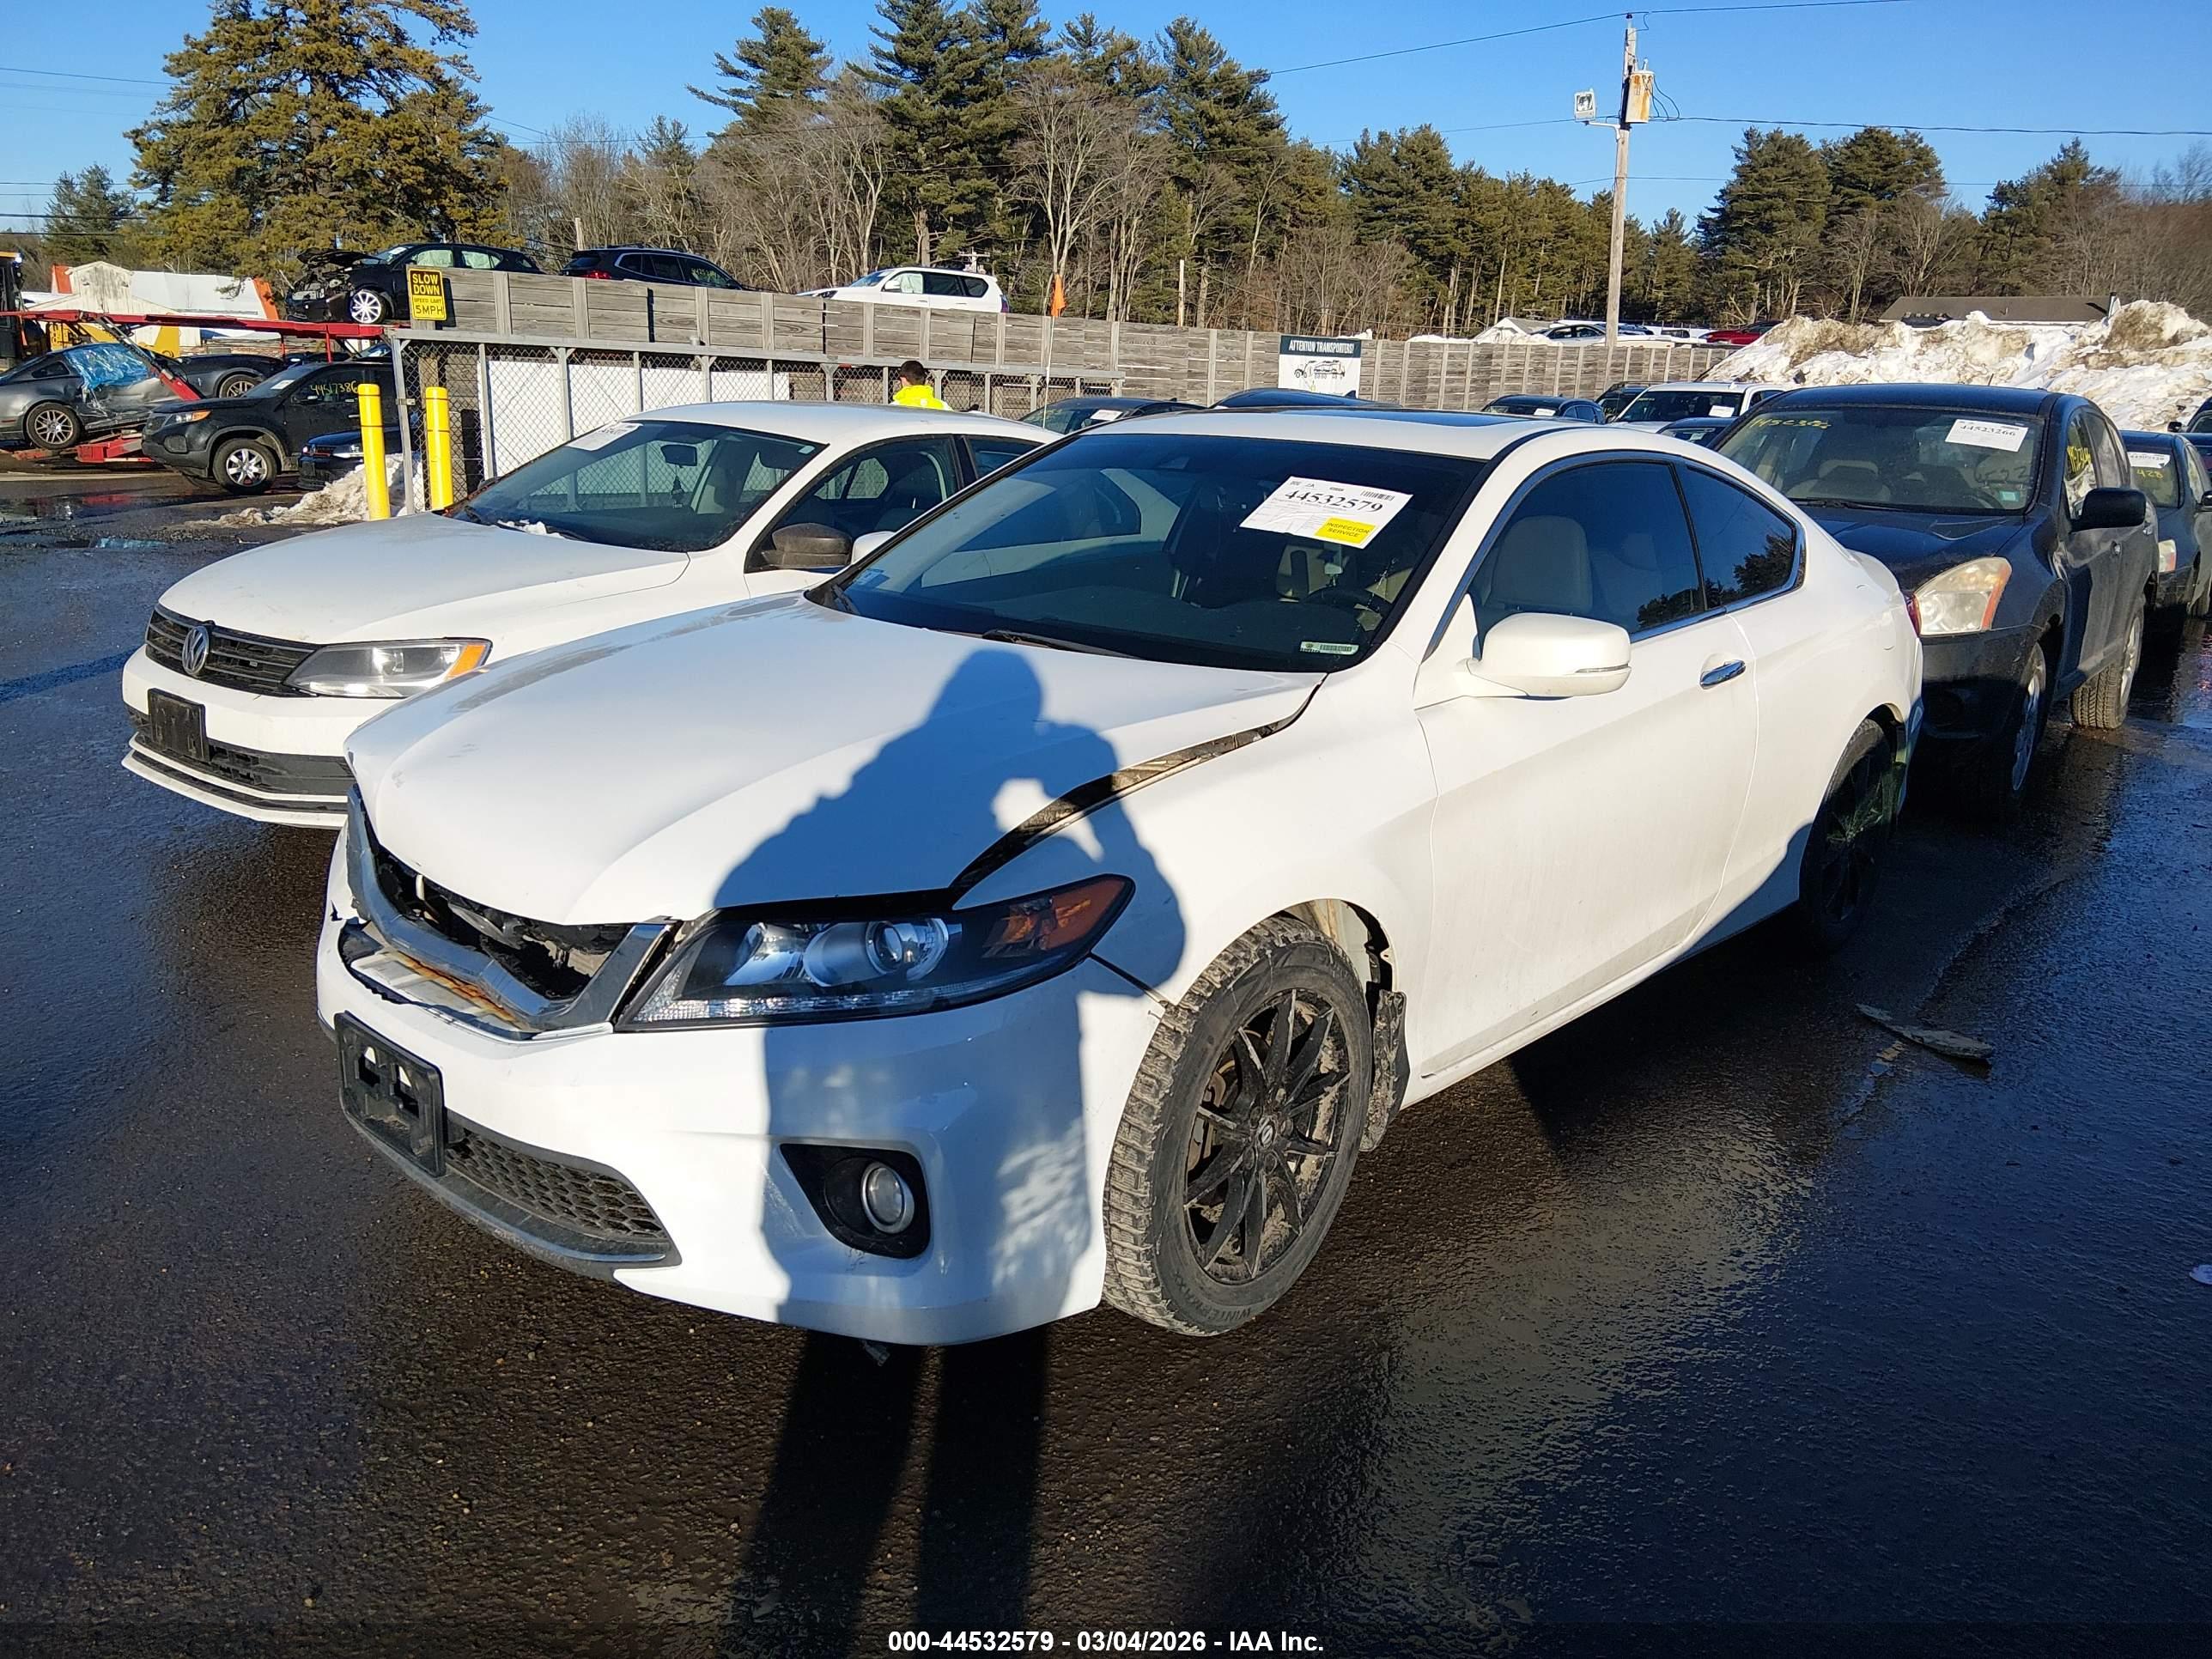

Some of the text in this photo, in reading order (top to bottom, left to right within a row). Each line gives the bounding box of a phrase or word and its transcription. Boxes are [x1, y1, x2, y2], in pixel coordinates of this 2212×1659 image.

[412, 273, 438, 285] SLOW
[413, 284, 440, 295] DOWN
[1289, 339, 1355, 355] ATTENTION TRANSPORTERS!
[1285, 489, 1383, 513] 44532579
[1327, 522, 1370, 534] INSPECTION
[1327, 527, 1360, 538] SERVICE
